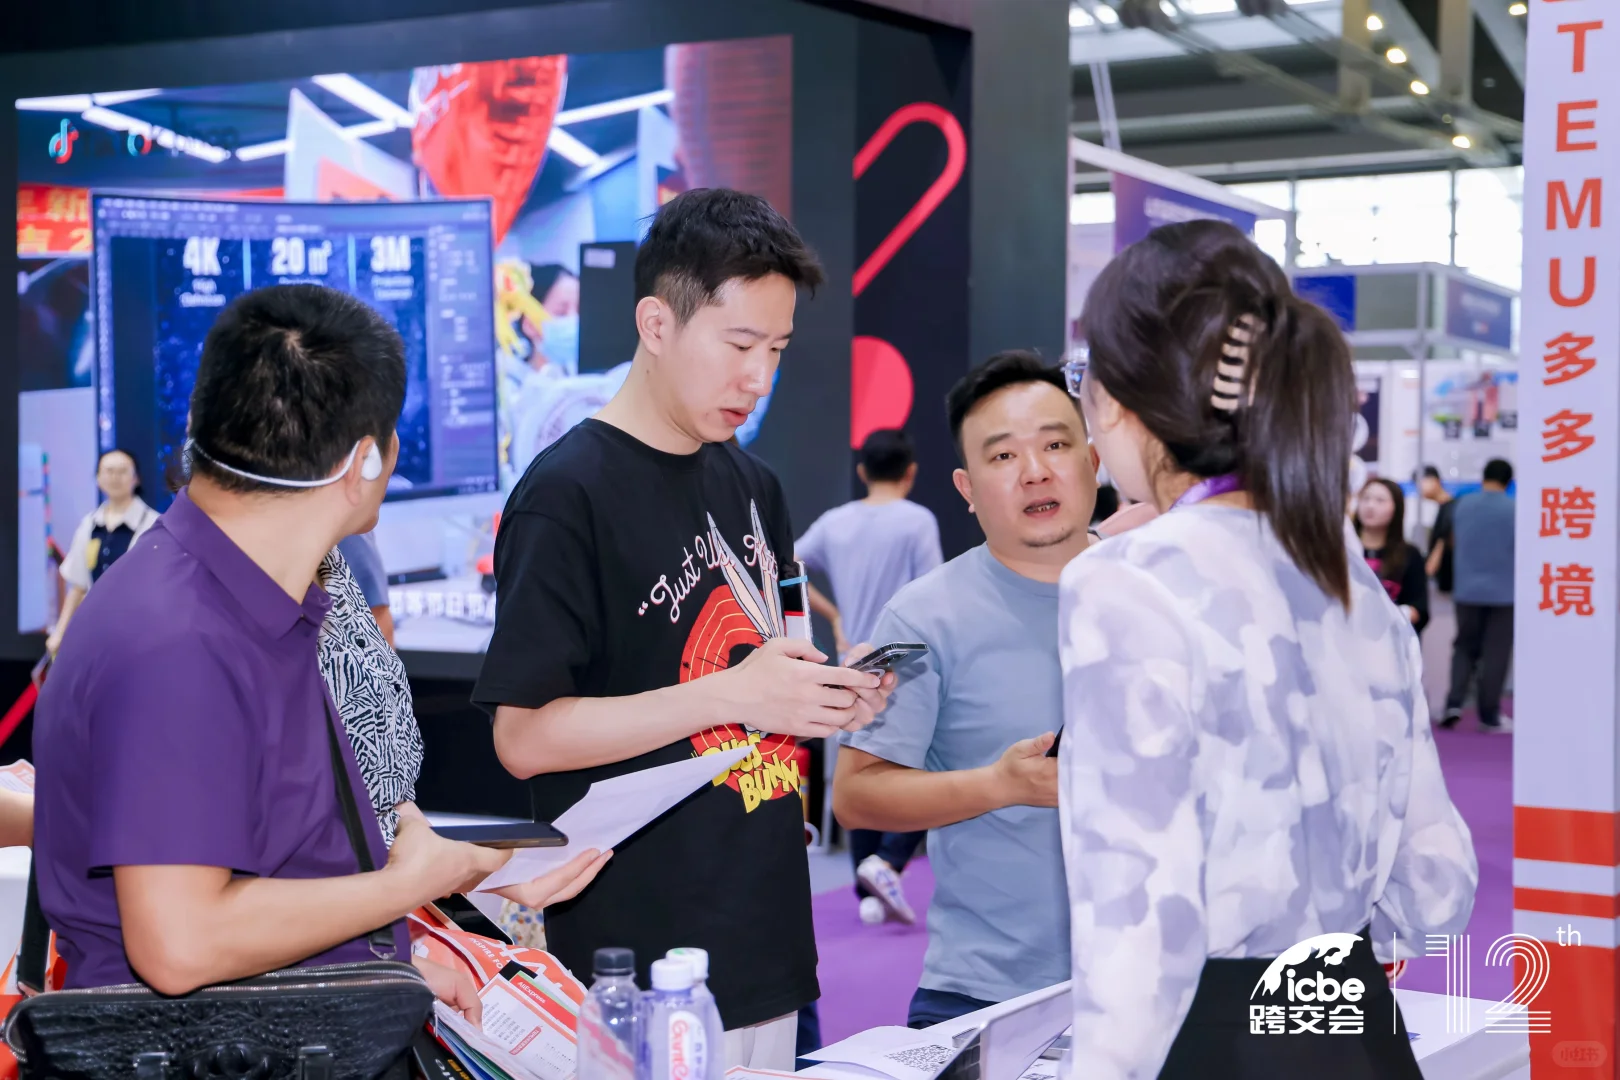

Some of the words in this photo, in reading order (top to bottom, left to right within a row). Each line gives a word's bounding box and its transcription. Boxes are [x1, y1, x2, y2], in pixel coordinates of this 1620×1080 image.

[183, 236, 221, 276] 4K
[271, 237, 305, 275] 20
[370, 236, 412, 272] 3M
[1538, 331, 1597, 617] 多多跨境
[738, 753, 802, 813] BUNN
[517, 981, 546, 1004] AliExpress
